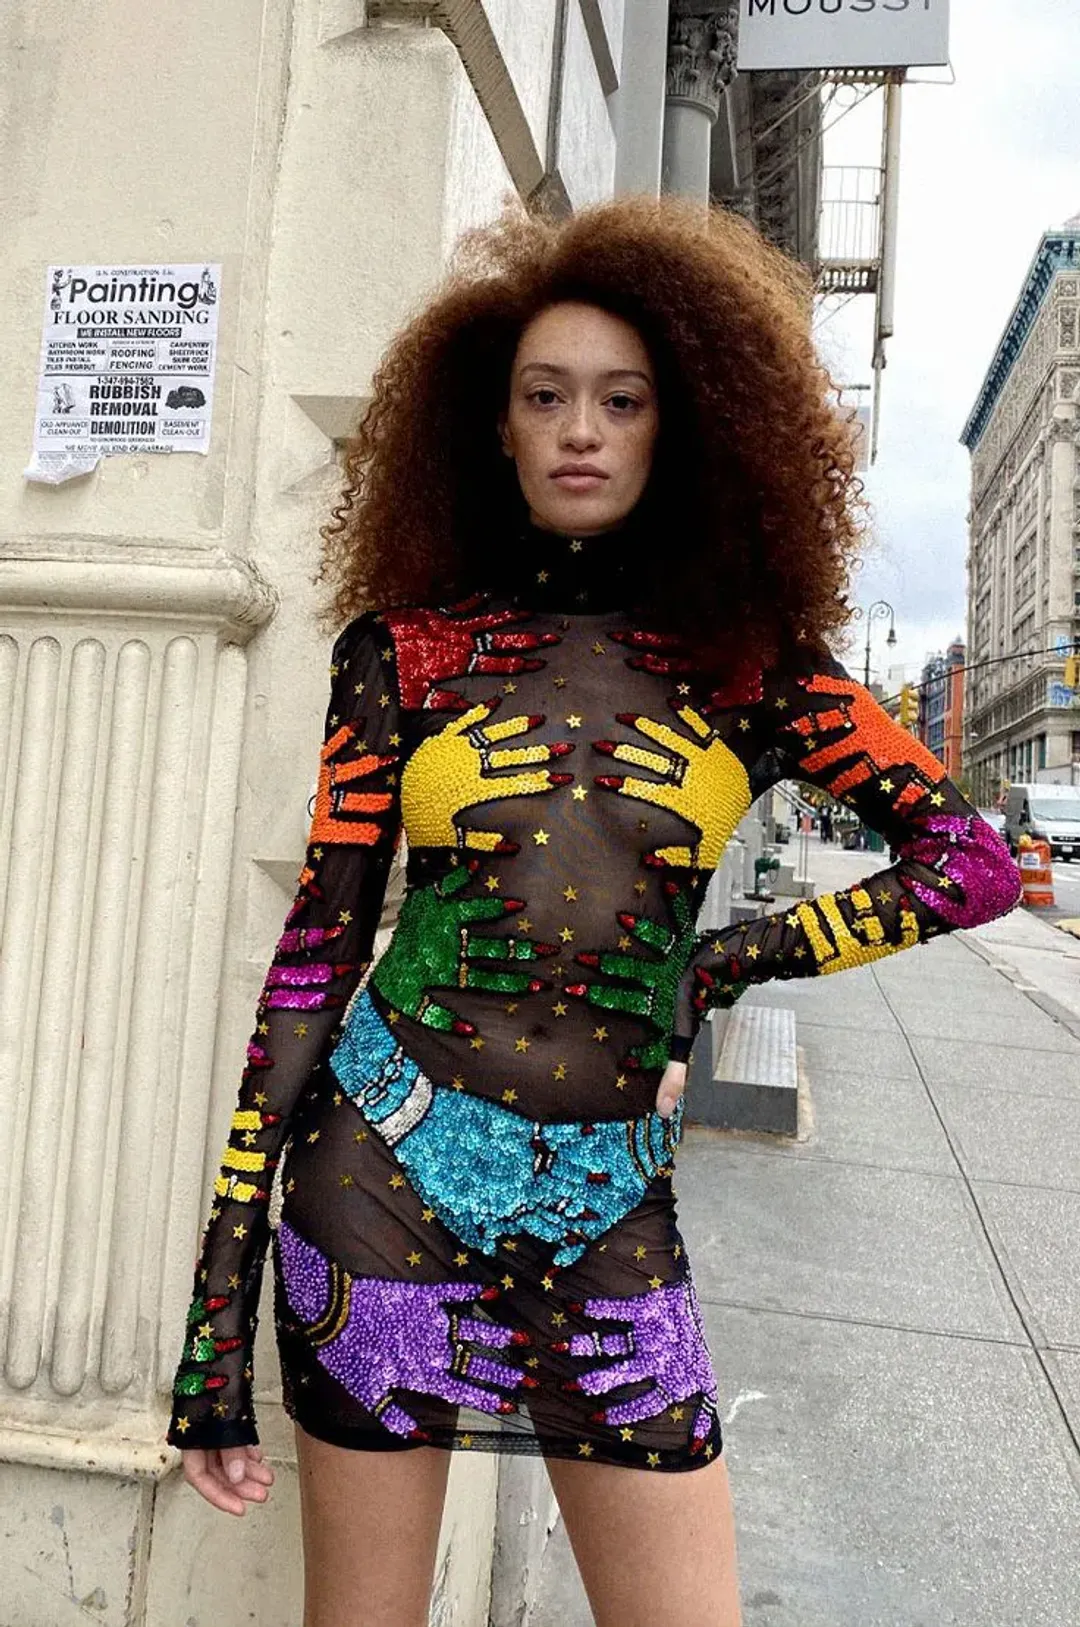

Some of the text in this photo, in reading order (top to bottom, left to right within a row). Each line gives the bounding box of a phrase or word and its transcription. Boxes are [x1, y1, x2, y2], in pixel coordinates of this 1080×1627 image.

[69, 277, 199, 309] Painting
[54, 310, 209, 325] FLOOR SANDING
[80, 328, 180, 337] WE INSTALL NEW FLOORS
[111, 349, 155, 357] ROOFING
[109, 361, 153, 369] FENCING
[89, 385, 161, 399] RUBBISH
[90, 402, 158, 416] REMOVAL
[91, 421, 155, 435] DEMOLITION
